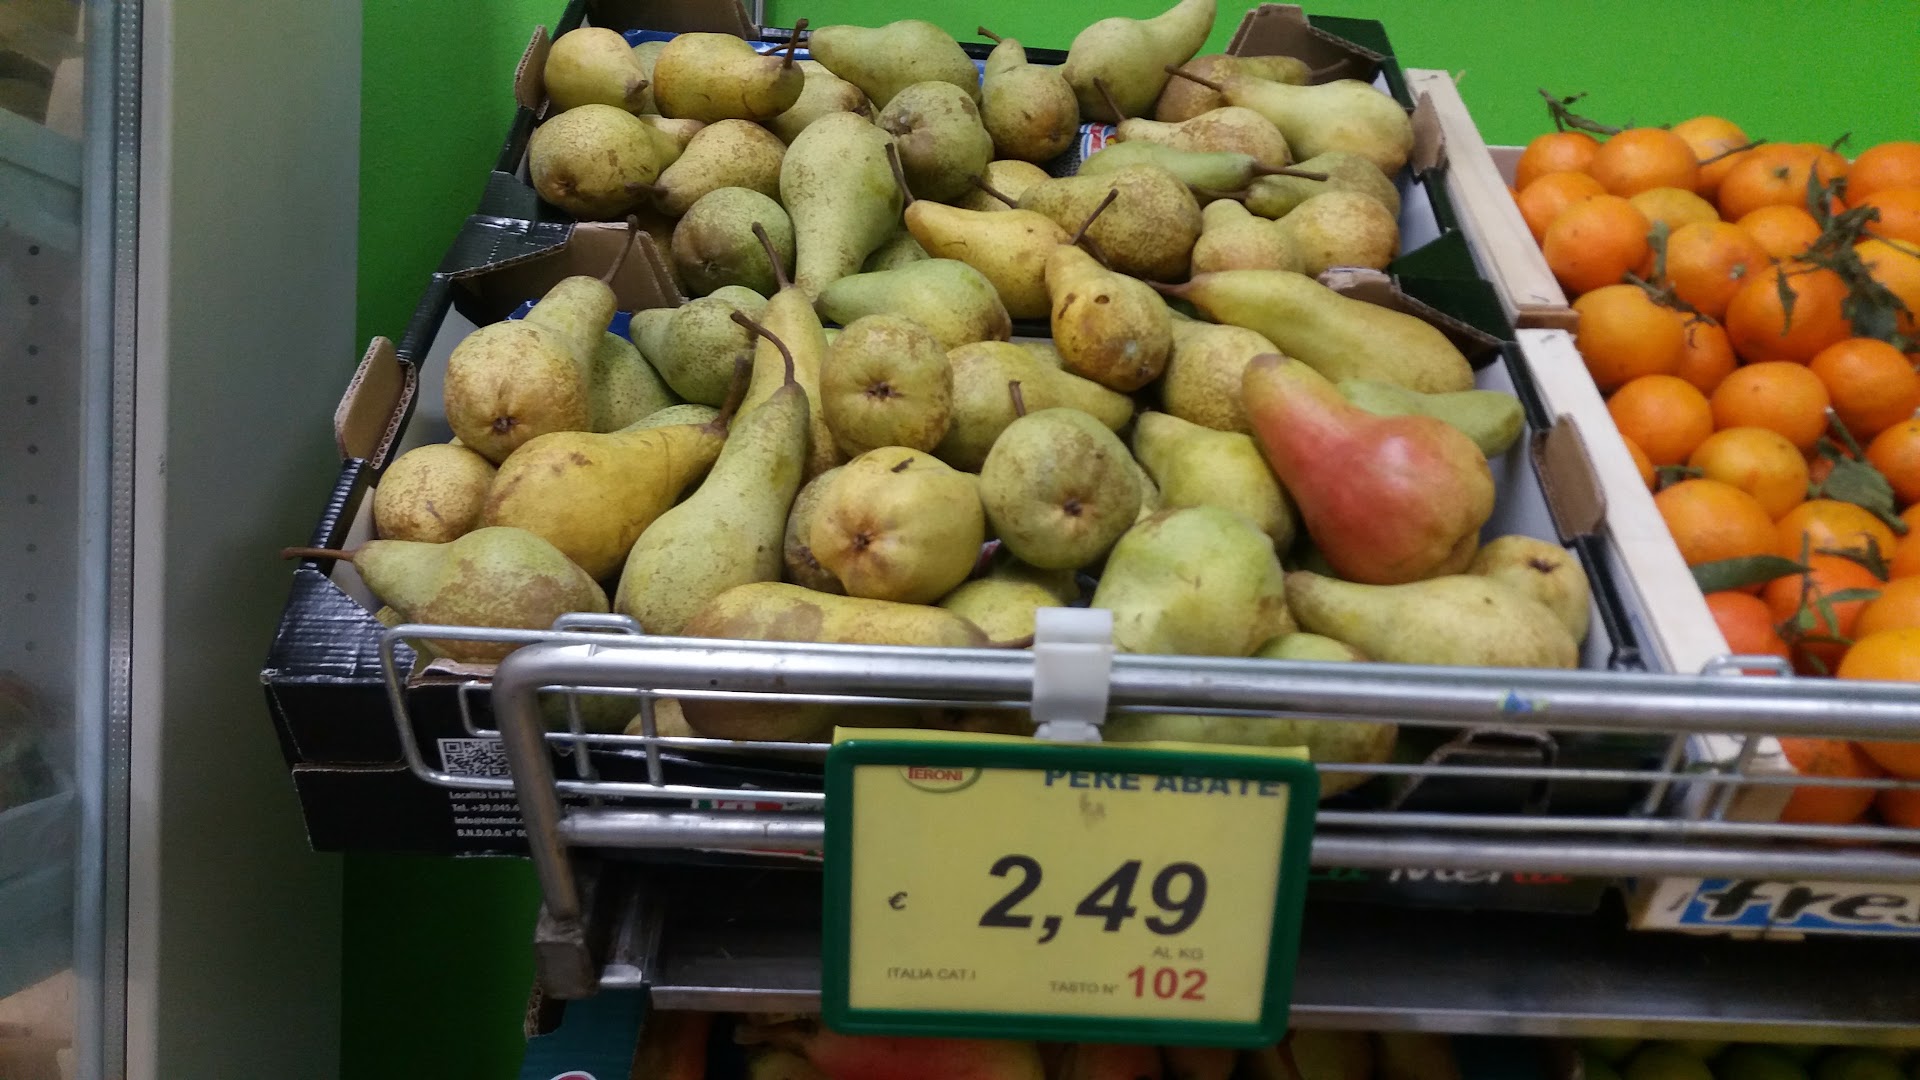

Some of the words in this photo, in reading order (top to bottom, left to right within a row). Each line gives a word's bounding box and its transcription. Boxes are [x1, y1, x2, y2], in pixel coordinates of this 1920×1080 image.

[1044, 769, 1141, 790] PERE
[1153, 775, 1280, 797] ABATE
[501, 791, 516, 799] Me
[471, 803, 520, 812] +39.045.6
[888, 891, 907, 911] €
[979, 854, 1208, 944] 2,49
[1703, 879, 1920, 926] fre
[1152, 946, 1172, 959] AL
[1179, 948, 1204, 960] KG
[887, 966, 933, 980] ITALIA
[1049, 980, 1099, 993] TASTO
[1127, 965, 1209, 1001] 102
